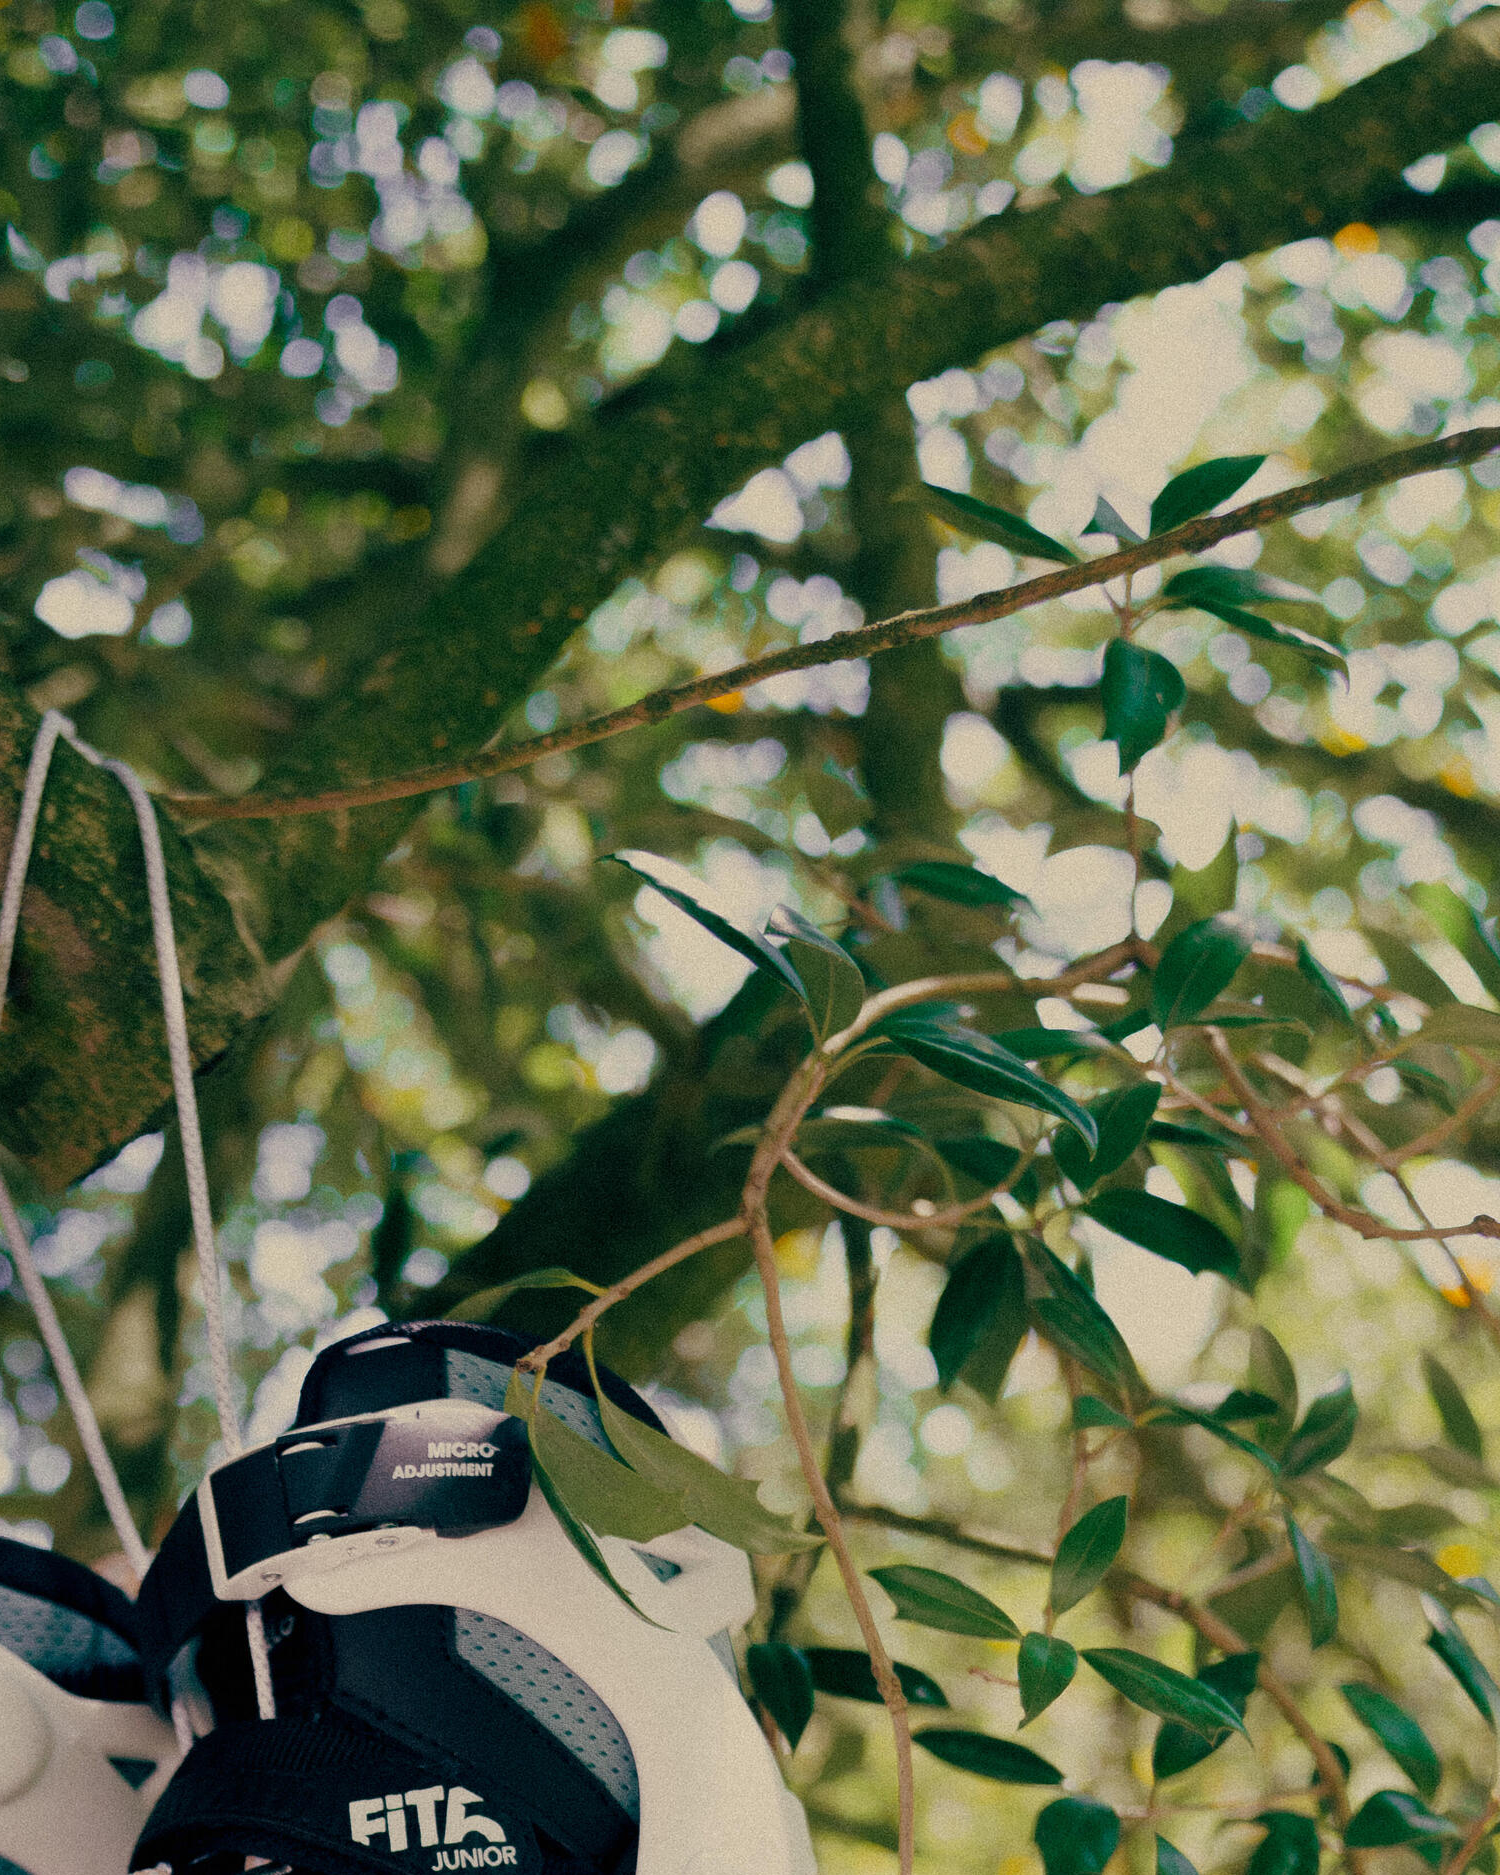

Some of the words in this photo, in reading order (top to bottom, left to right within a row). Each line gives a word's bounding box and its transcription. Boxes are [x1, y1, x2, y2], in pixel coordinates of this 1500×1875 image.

[427, 1442, 496, 1459] MICRO
[392, 1462, 494, 1480] ADJUSTMENT
[431, 1845, 518, 1872] JUNIOR
